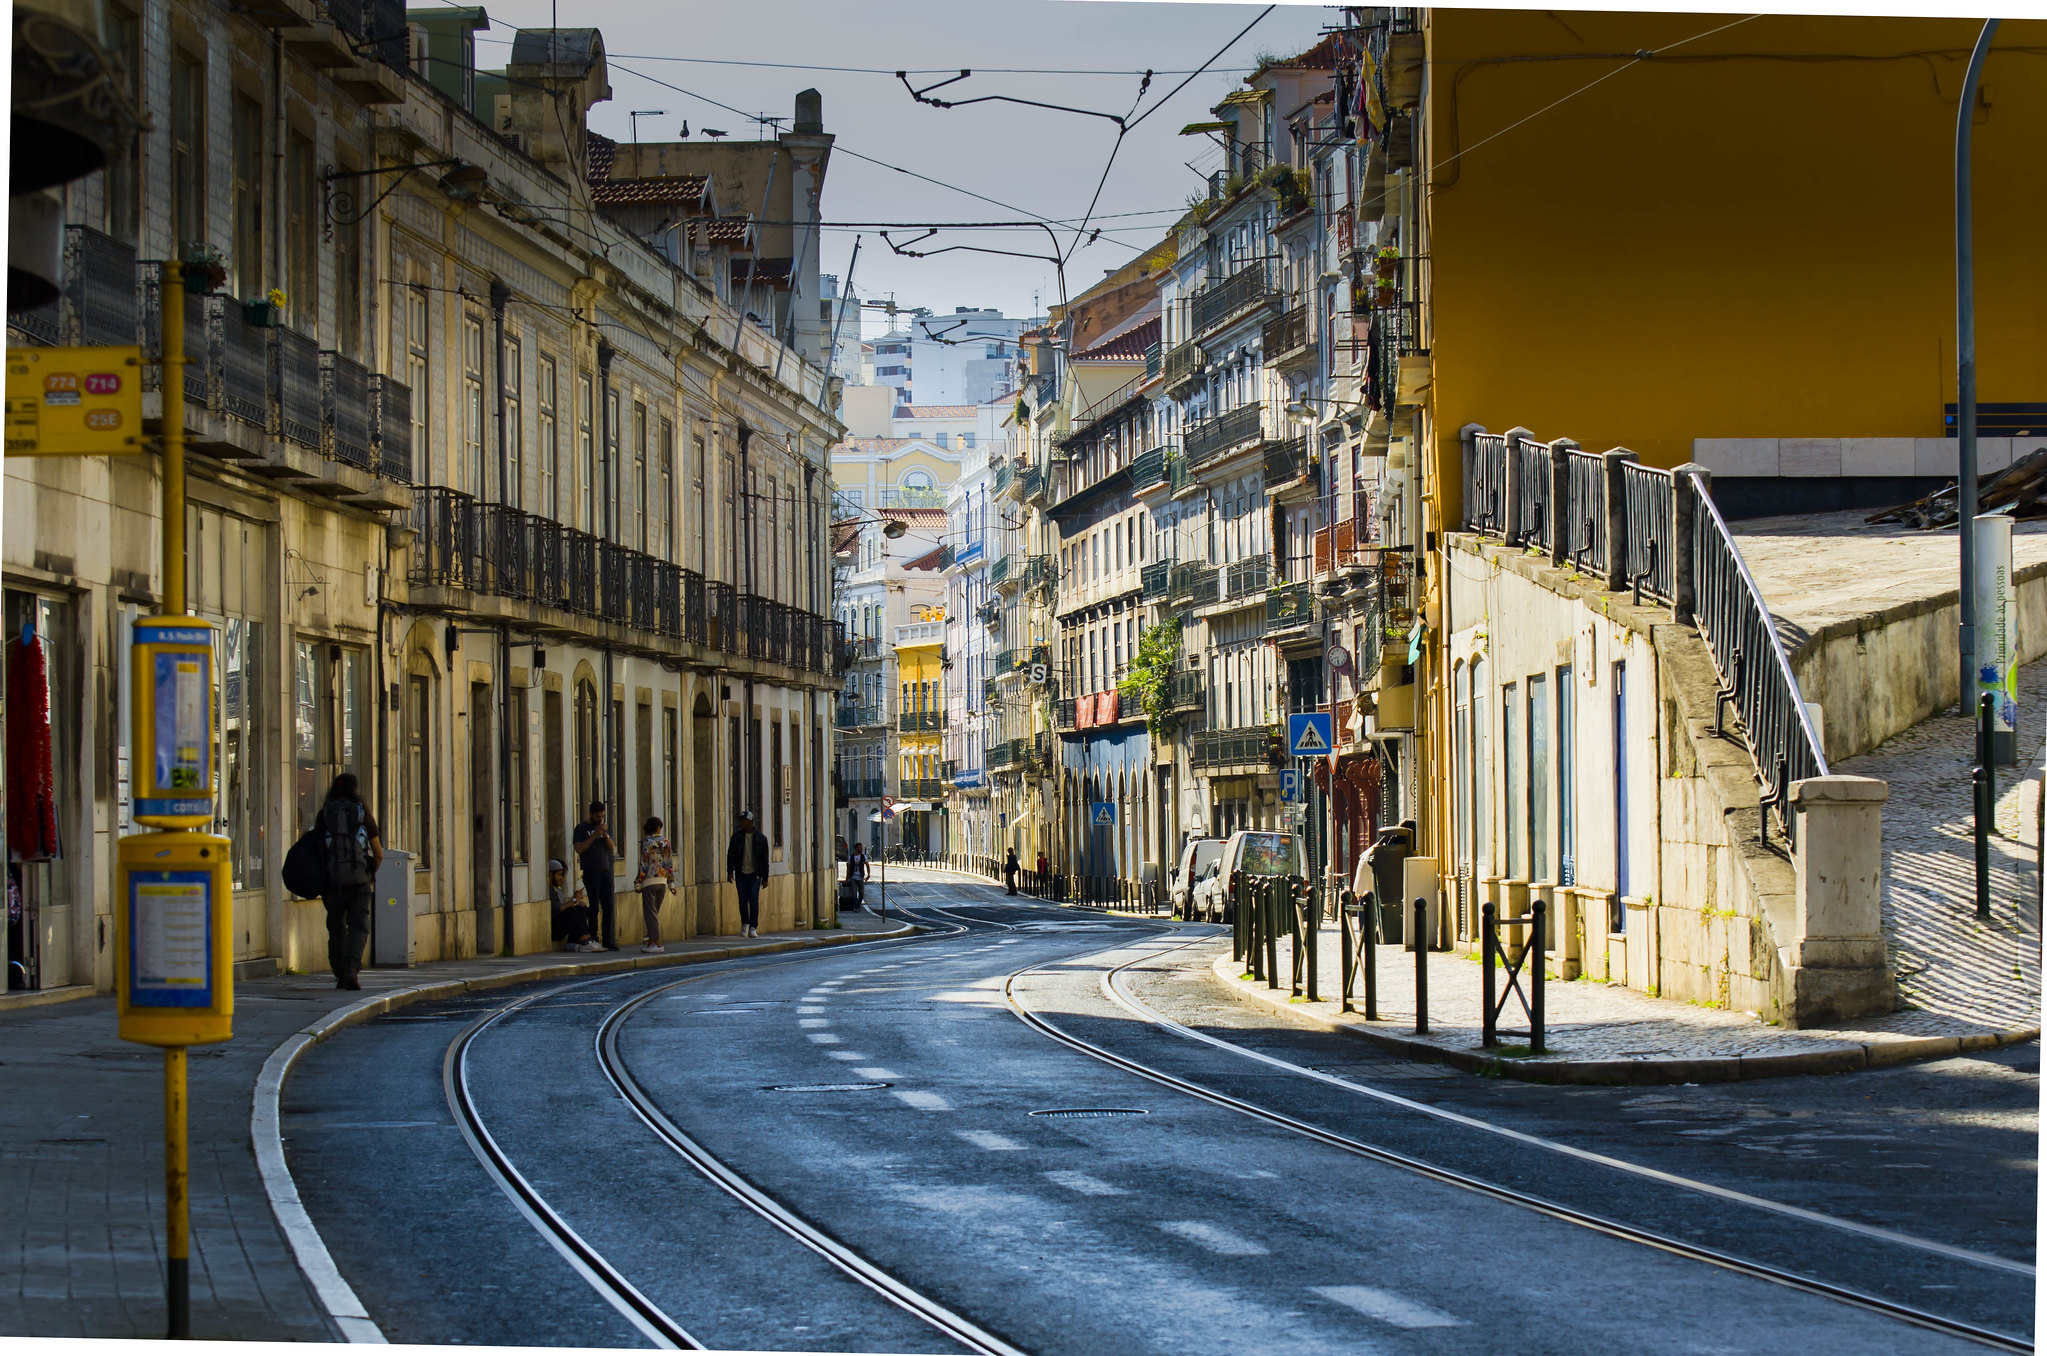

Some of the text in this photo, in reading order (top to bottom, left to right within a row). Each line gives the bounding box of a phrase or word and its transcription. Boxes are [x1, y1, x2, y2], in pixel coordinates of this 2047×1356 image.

[50, 376, 77, 389] 774
[89, 378, 117, 390] 714
[89, 414, 119, 427] 25E
[1996, 565, 2007, 601] pessoas
[1995, 616, 2006, 664] Prioridade
[1033, 666, 1044, 681] S
[1284, 773, 1297, 793] P
